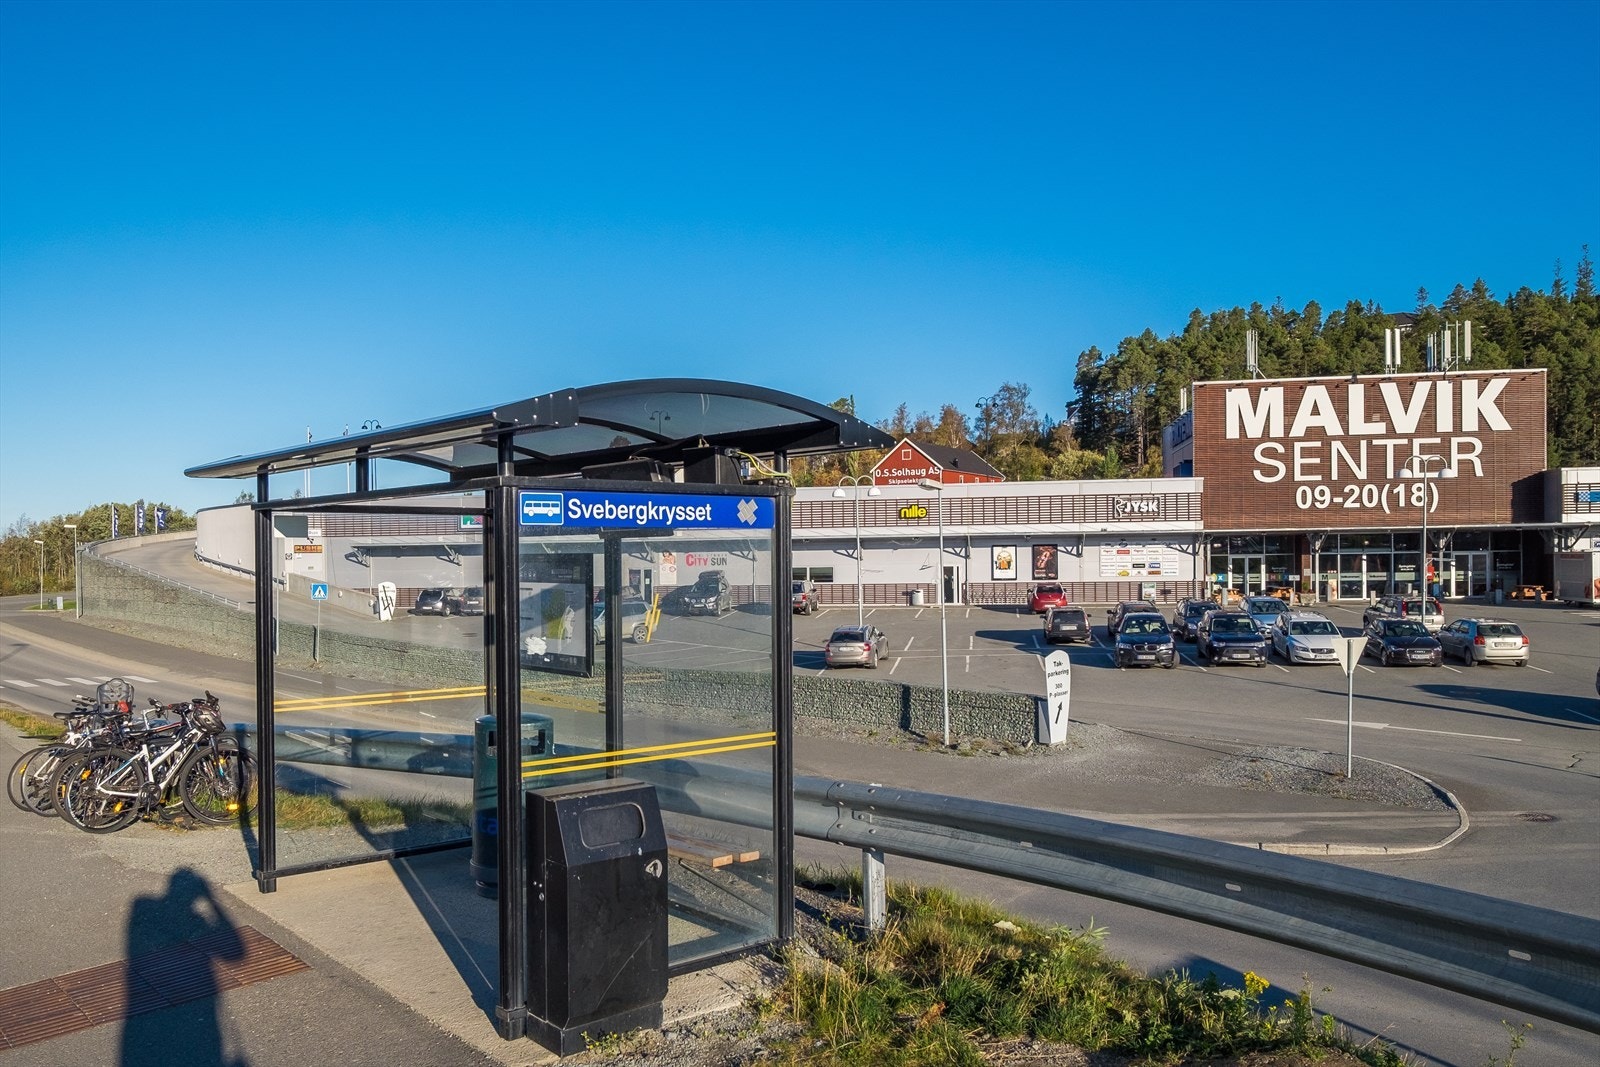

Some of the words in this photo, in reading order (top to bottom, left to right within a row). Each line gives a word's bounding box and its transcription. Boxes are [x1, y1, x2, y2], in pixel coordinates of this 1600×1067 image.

[1225, 378, 1512, 439] MALVIK
[1253, 436, 1483, 482] SENTER
[928, 466, 941, 475] AS
[1296, 482, 1439, 513] 09-20(18)
[568, 498, 712, 527] Svebergkrysset
[900, 504, 927, 518] nille
[1124, 500, 1159, 513] JYSK
[710, 557, 728, 566] SUN
[1047, 669, 1069, 678] parkering
